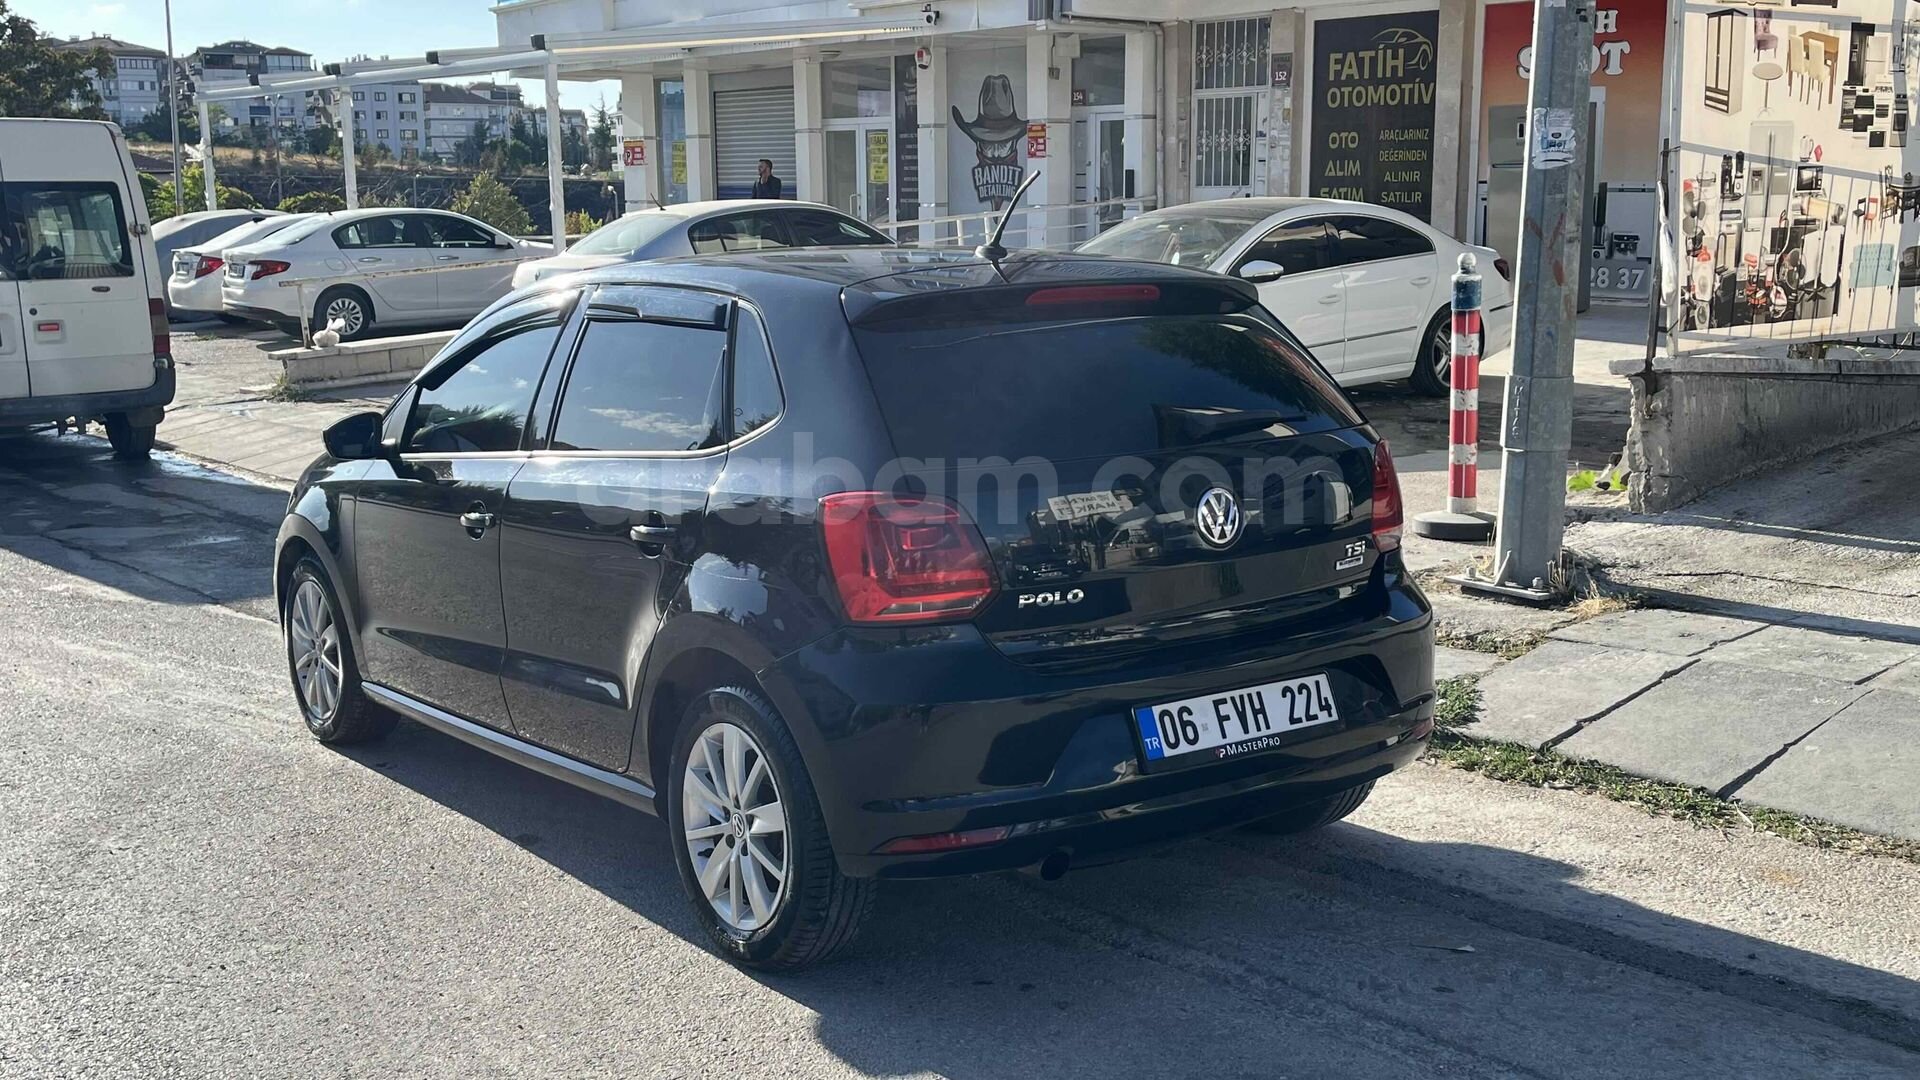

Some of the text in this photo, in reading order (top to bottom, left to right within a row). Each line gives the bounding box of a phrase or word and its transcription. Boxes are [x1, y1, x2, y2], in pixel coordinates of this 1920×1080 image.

[1328, 43, 1405, 81] FATİH
[1275, 71, 1287, 81] 152
[1327, 77, 1435, 108] OTOMOTİV
[1328, 131, 1359, 149] OTO
[1379, 128, 1430, 143] ARAÇLARINIZ
[1379, 147, 1428, 162] DEĞERİNDEN
[974, 164, 1022, 186] BANDIT
[1324, 159, 1361, 177] ALIM
[1383, 170, 1421, 183] ALINIR
[978, 183, 1016, 199] DETAILING
[1320, 187, 1364, 202] SATIM
[1381, 190, 1422, 204] SATILIR
[1616, 267, 1645, 290] 37
[1018, 588, 1085, 609] POLO
[1158, 679, 1333, 750] 06 FVH 224
[1145, 737, 1161, 751] TR
